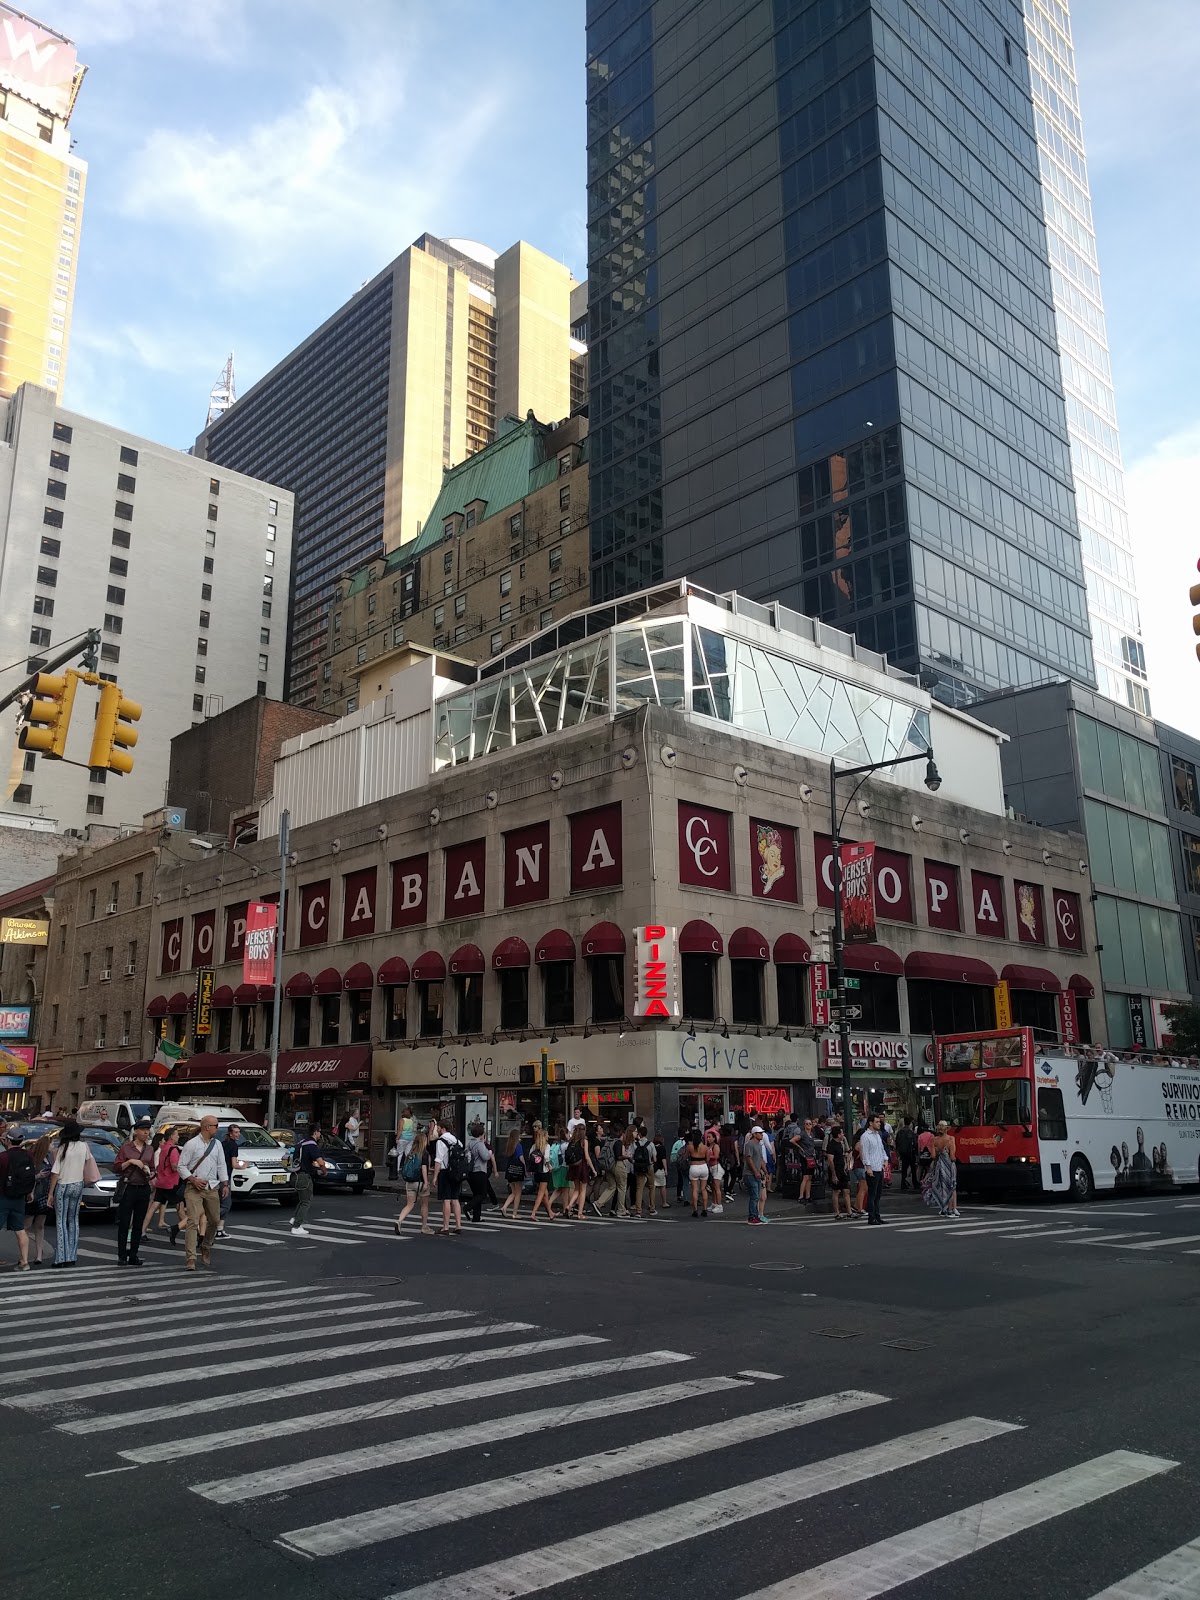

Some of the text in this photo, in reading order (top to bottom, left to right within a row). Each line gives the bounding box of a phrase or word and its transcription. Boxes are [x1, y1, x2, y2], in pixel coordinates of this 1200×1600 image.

[843, 856, 873, 882] JERSEY
[846, 876, 867, 898] BOYS
[167, 828, 617, 961] COPCABANA
[2, 928, 48, 942] Atkinson
[245, 928, 275, 946] JERSEY
[586, 942, 594, 953] C
[711, 940, 719, 951] C
[248, 944, 269, 960] BOYS
[539, 950, 546, 960] C
[759, 947, 766, 958] C
[803, 952, 809, 962] C
[495, 956, 502, 966] C
[874, 961, 881, 971] C
[451, 963, 458, 972] C
[644, 925, 670, 1017] PIZZA
[379, 974, 385, 983] C
[413, 969, 420, 979] C
[962, 972, 968, 982] C
[344, 980, 350, 989] C
[848, 979, 853, 987] 8
[1041, 982, 1046, 991] C
[285, 988, 291, 996] C
[313, 985, 319, 993] C
[814, 965, 824, 1024] LECTNICS
[1090, 988, 1094, 997] C
[832, 1009, 840, 1017] ON
[1000, 1009, 1008, 1027] SHO
[1062, 991, 1075, 1041] LIQUORS
[1133, 1015, 1144, 1044] GIFTS
[828, 1038, 910, 1059] ELCTRONICS
[681, 1037, 806, 1073] Carve Unique Sandwiches
[287, 1059, 342, 1073] ANDY'S DELI
[437, 1051, 520, 1081] Carve Uniq
[227, 1068, 268, 1076] COPACABAN
[816, 1087, 830, 1095] ATM
[1161, 1082, 1200, 1100] SURVIVO
[746, 1088, 790, 1113] PIZZA
